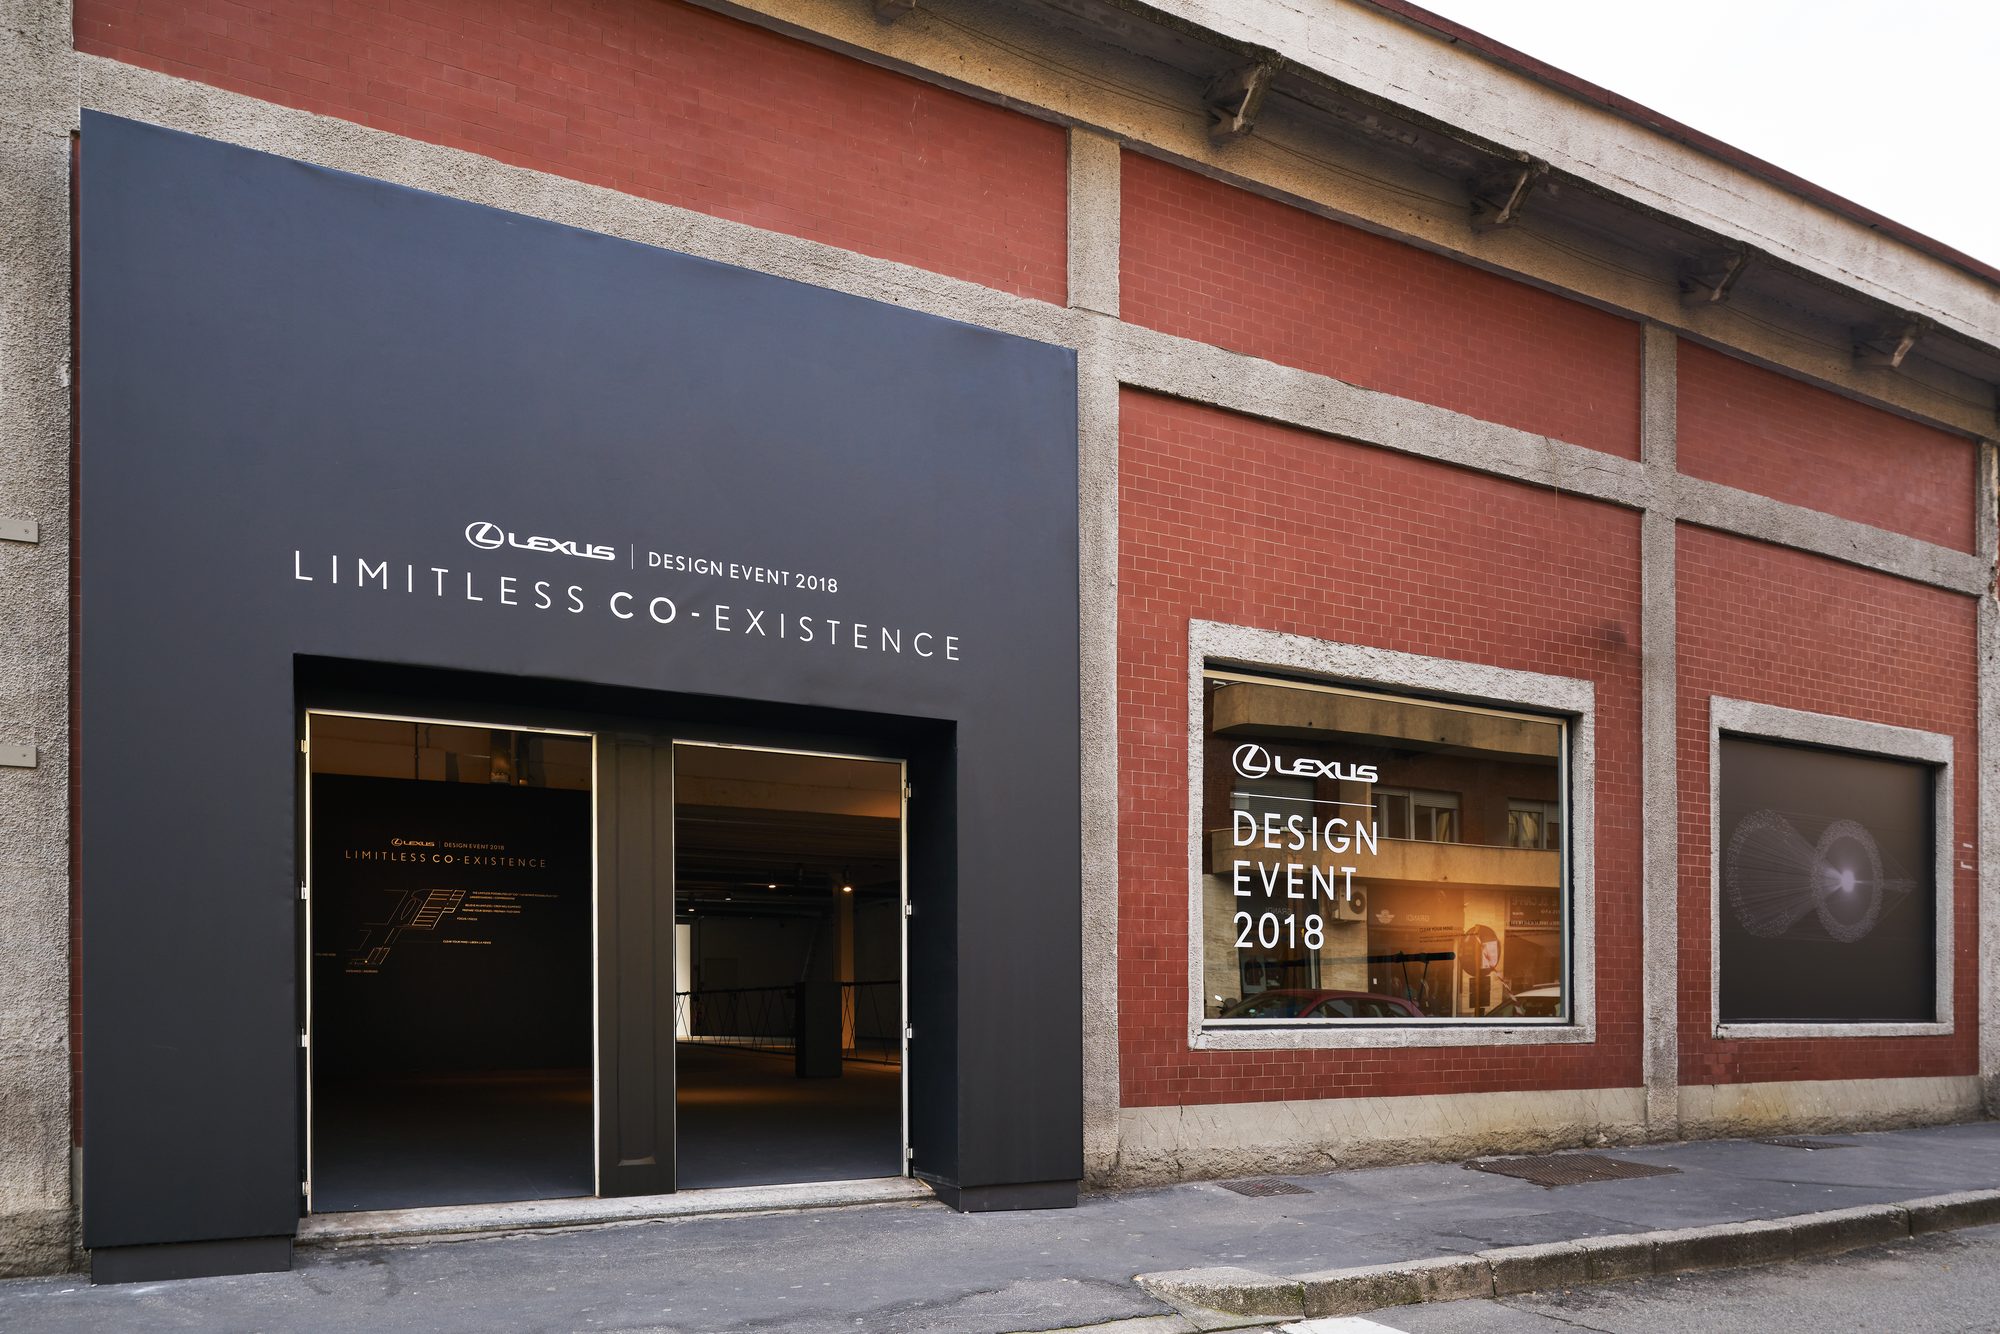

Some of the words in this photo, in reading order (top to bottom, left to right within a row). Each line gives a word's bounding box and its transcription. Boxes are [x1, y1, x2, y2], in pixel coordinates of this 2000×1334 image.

[507, 532, 616, 561] LEXUS
[648, 551, 723, 577] DESIGN
[729, 563, 790, 588] EVENT
[795, 573, 838, 594] 2018
[295, 549, 584, 614] LIMITLESS
[609, 591, 960, 662] CO-EXISTENCE
[1274, 755, 1379, 784] LEXUS
[403, 839, 435, 848] LEXUS
[443, 841, 468, 850] DESIGN
[1233, 810, 1378, 856] DESIGN
[345, 849, 427, 864] LIMITLESS
[1233, 860, 1357, 902] EVENT
[1233, 911, 1325, 950] 2018
